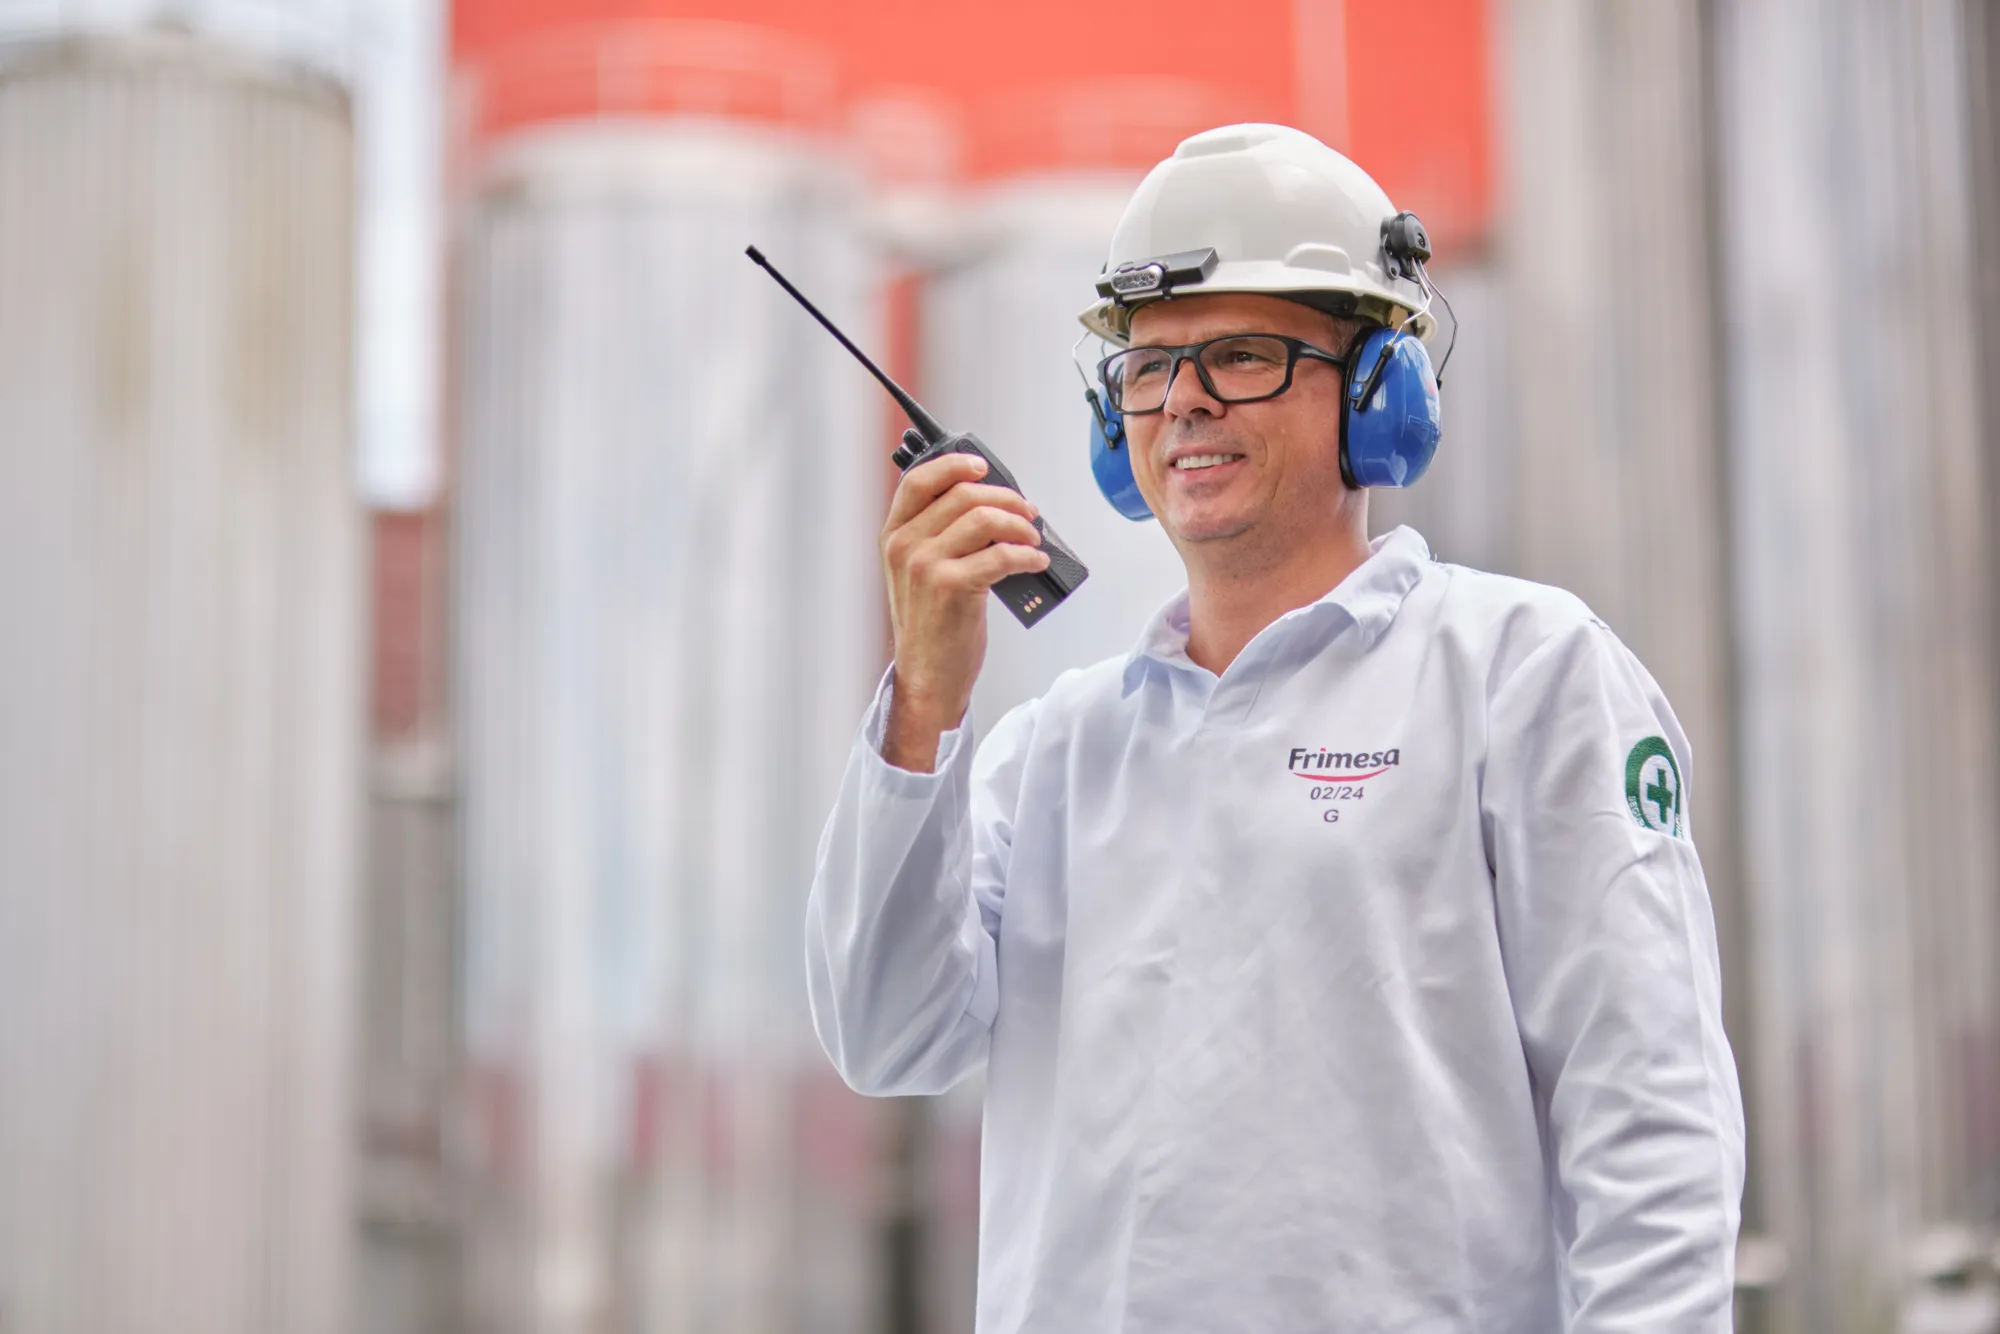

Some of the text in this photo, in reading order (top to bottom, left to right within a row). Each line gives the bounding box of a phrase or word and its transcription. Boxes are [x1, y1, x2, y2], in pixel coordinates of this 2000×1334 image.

[1288, 747, 1400, 770] Frimesa
[1309, 786, 1364, 801] 02/24
[1323, 808, 1340, 824] G
